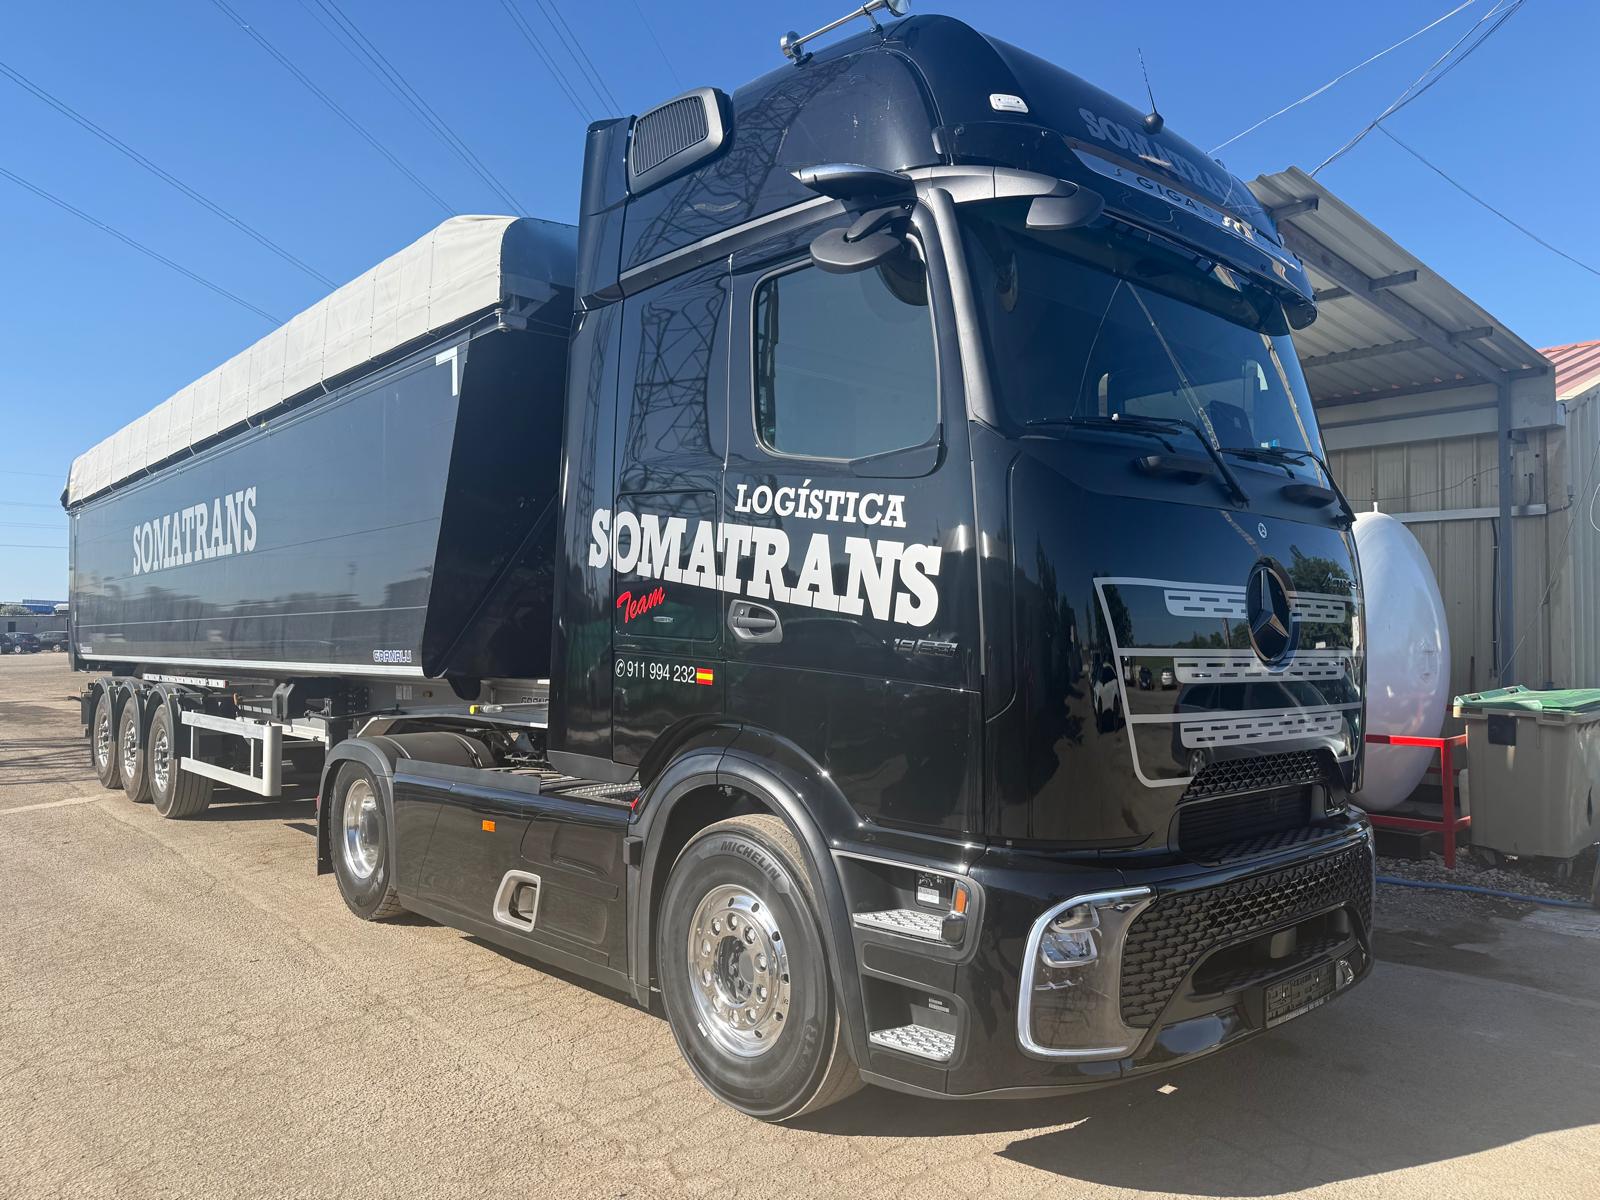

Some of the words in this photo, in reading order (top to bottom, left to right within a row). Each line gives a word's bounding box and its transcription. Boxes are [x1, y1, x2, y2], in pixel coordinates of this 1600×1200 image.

[734, 479, 907, 528] LOGÍSTICA
[133, 486, 258, 575] SOMATRANS
[588, 508, 943, 627] SOMATRANS
[616, 586, 666, 624] Team
[627, 661, 645, 678] 911
[649, 663, 670, 680] 994
[673, 665, 695, 683] 232
[720, 840, 781, 881] MICHELIN
